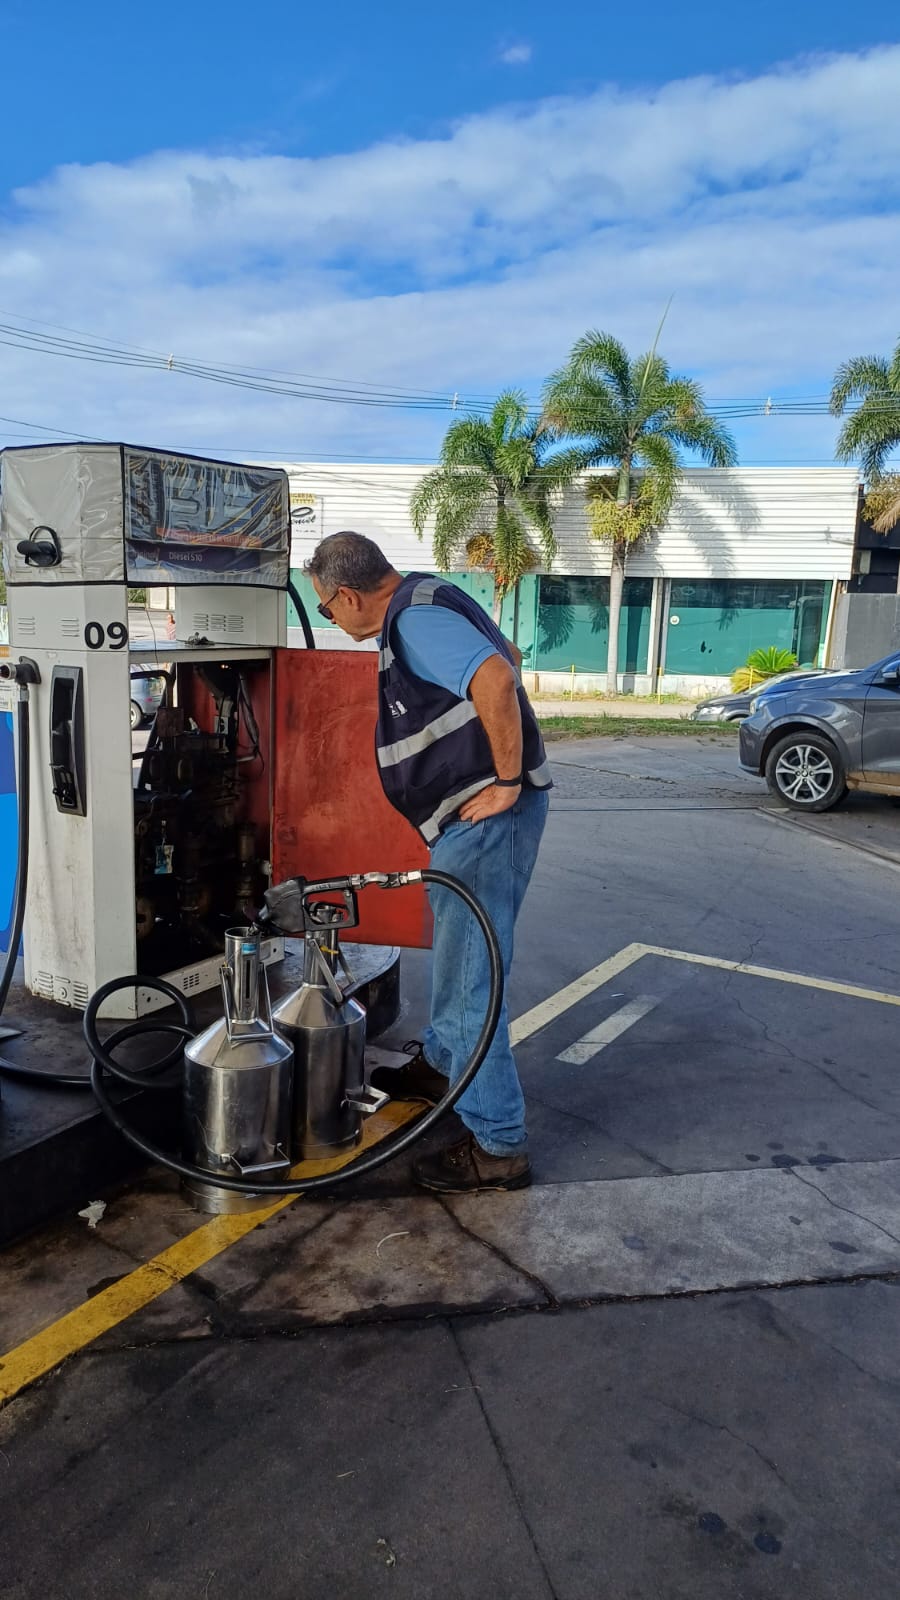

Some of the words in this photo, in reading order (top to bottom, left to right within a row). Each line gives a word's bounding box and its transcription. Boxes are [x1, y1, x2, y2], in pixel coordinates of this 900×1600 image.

[168, 551, 190, 561] Diesel
[190, 554, 203, 562] S10
[84, 621, 128, 650] 09
